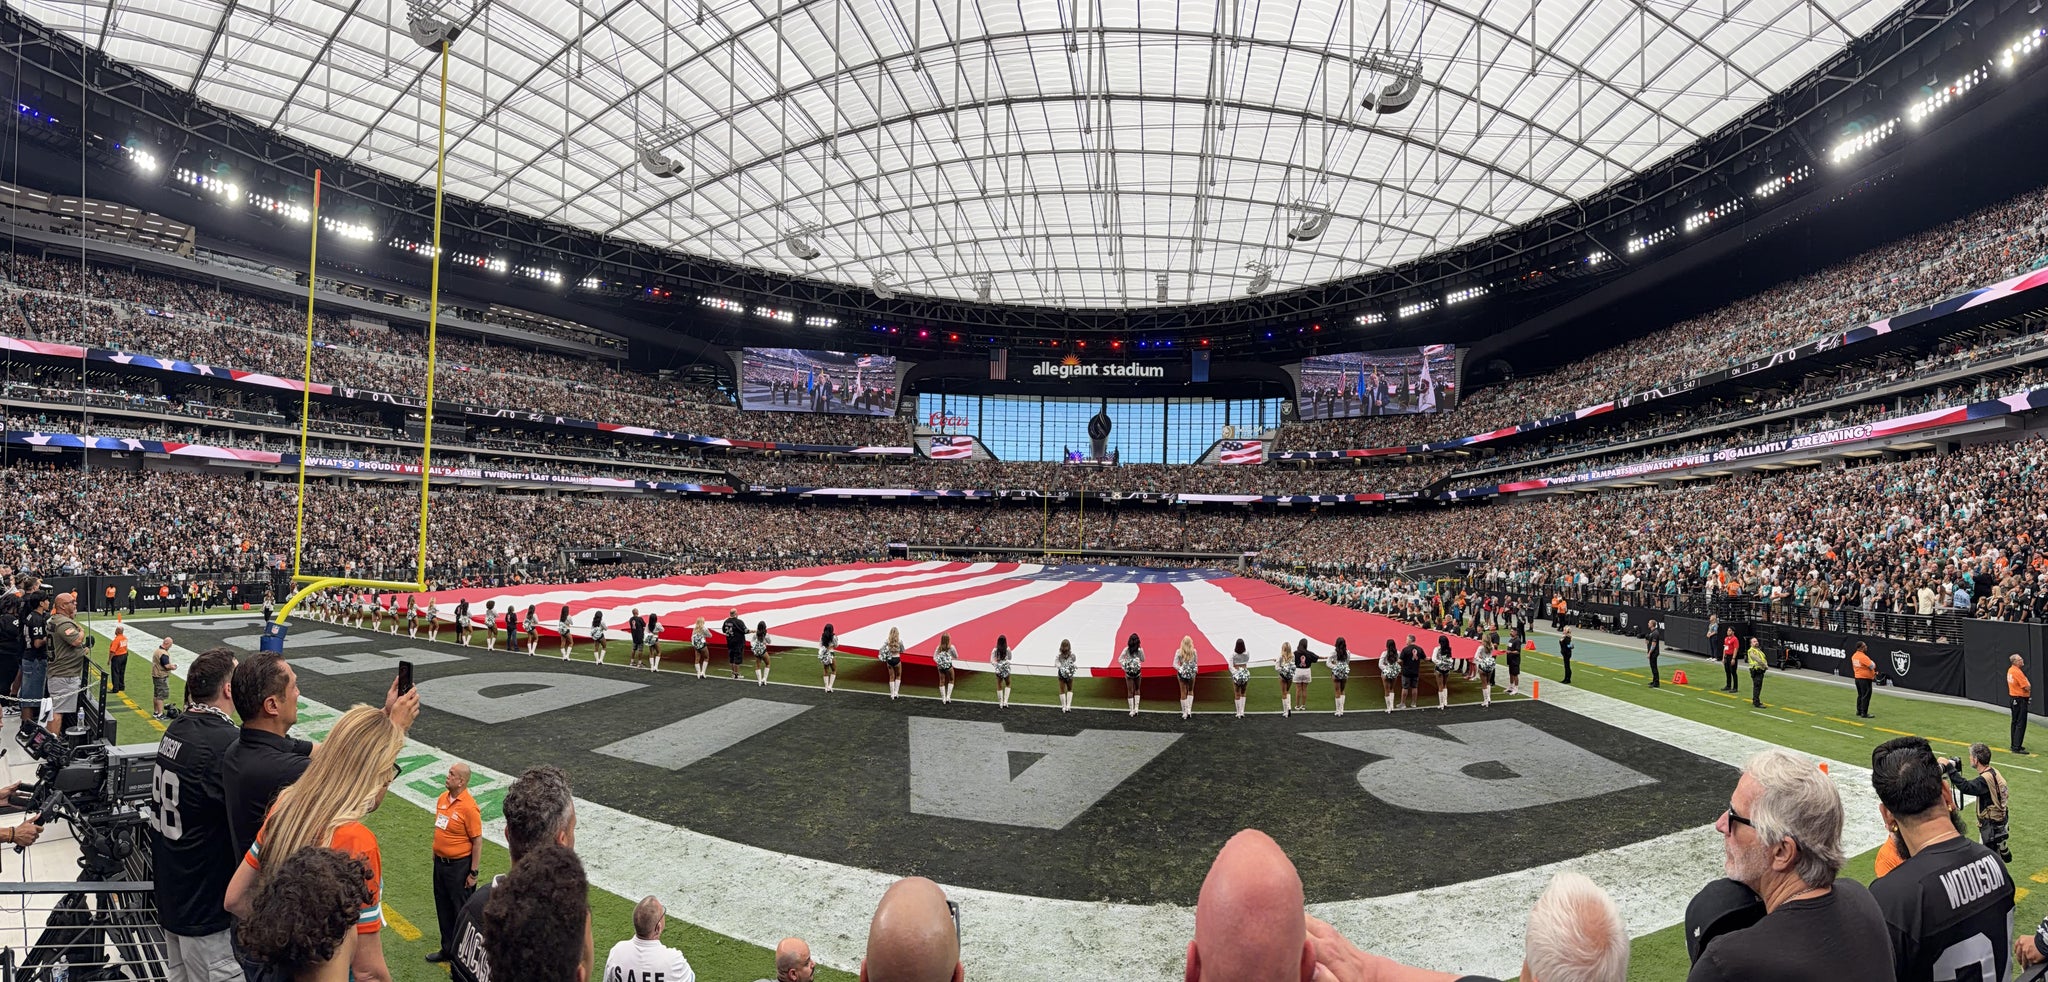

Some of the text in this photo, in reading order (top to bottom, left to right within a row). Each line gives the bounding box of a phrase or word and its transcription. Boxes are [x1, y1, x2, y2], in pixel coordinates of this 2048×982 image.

[1032, 362, 1164, 379] allegiant stadium
[1683, 380, 1695, 389] 5:47
[929, 411, 969, 427] Coors
[1577, 473, 1589, 481] THE
[1591, 467, 1629, 479] RAMPARTS
[1629, 465, 1643, 474] WE
[1646, 460, 1683, 472] WATCH'D
[1686, 454, 1710, 466] WERE
[1713, 453, 1726, 461] SO
[1729, 440, 1787, 459] GALLANTLY
[1791, 425, 1873, 449] STREAMING?
[358, 461, 401, 471] PROUDLY
[404, 464, 419, 473] WE
[484, 471, 529, 480] TWILIGHT'S
[33, 626, 43, 636] 34
[1828, 623, 1838, 631] 117
[1811, 644, 1846, 659] RAIDERS
[151, 763, 183, 841] 98
[1939, 854, 2005, 910] WOODSON
